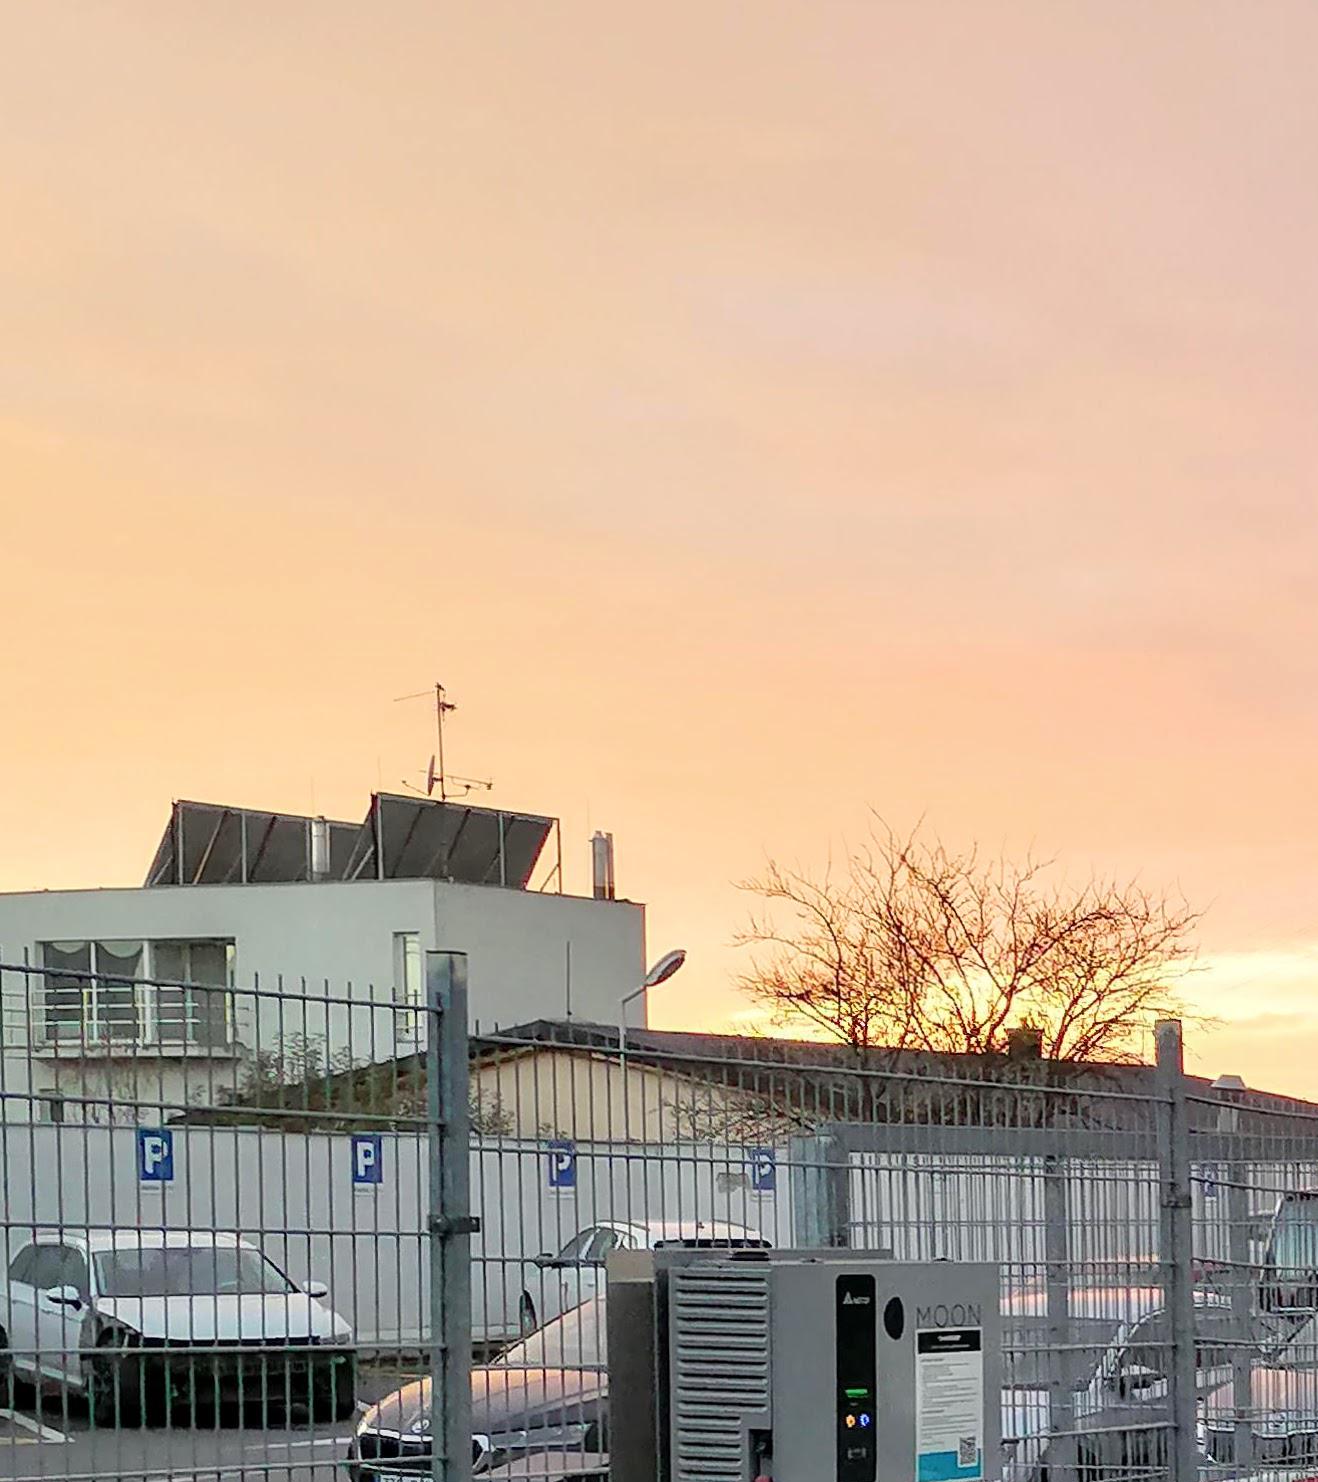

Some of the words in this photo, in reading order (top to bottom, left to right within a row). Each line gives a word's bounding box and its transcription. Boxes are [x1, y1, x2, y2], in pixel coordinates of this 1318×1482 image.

[143, 1135, 169, 1174] P
[356, 1141, 375, 1177] P
[916, 1303, 981, 1329] MOON
